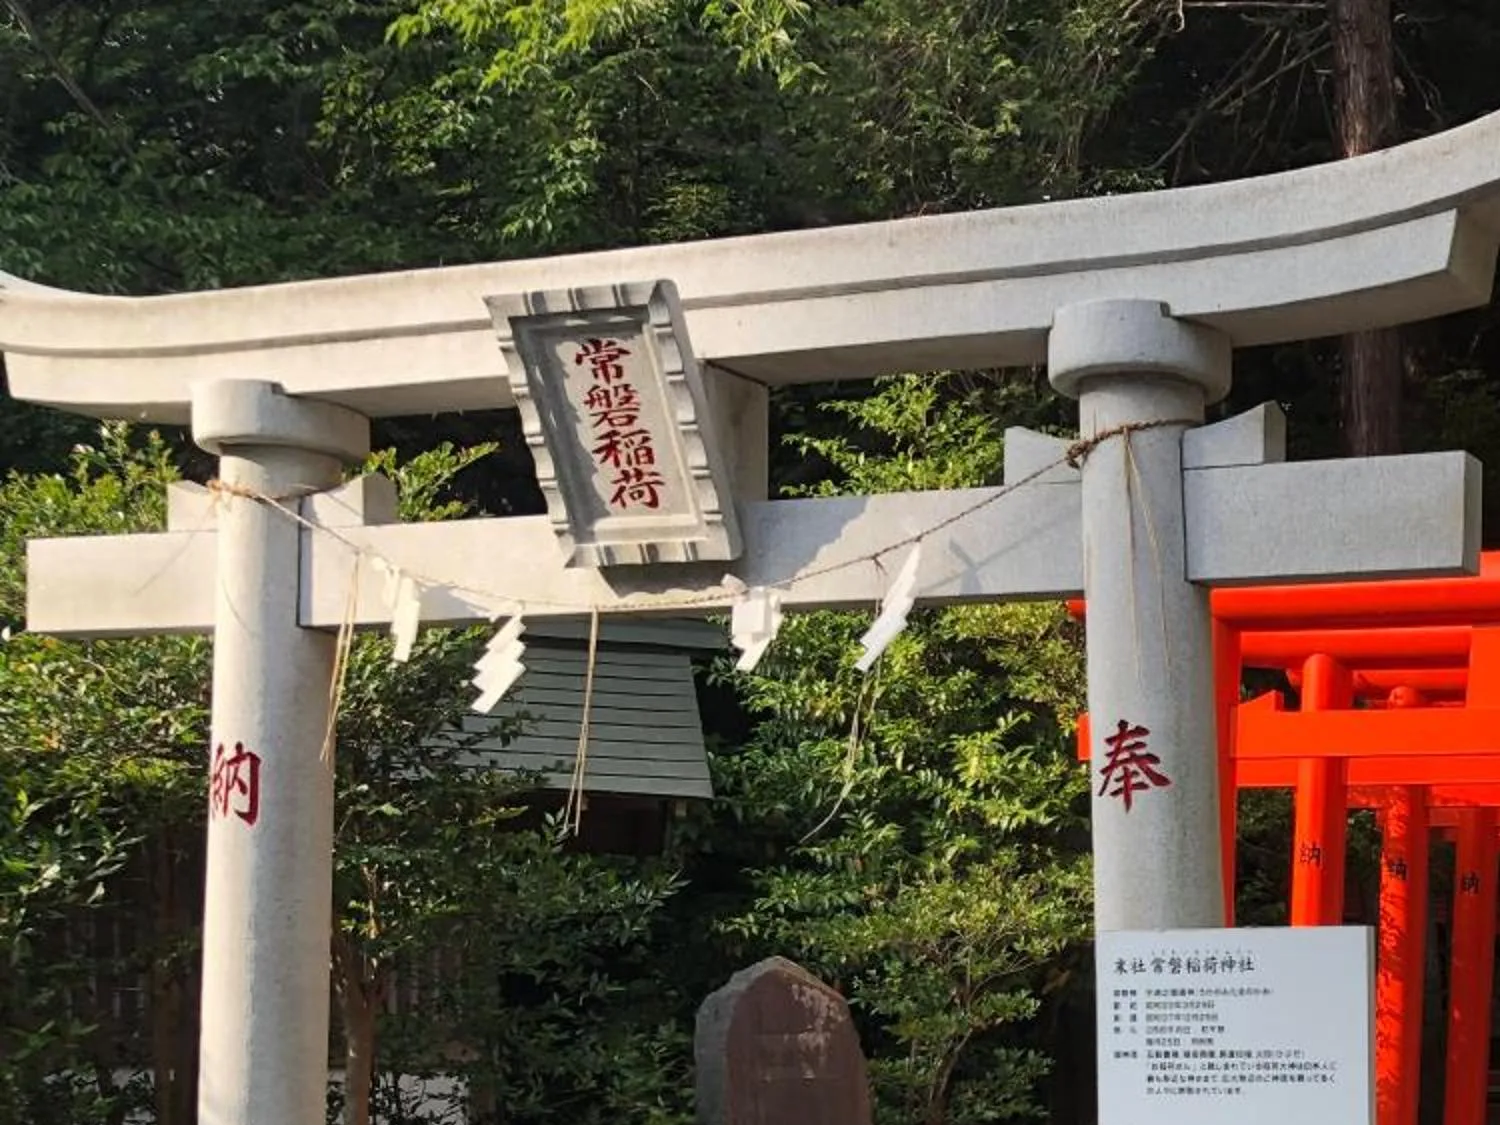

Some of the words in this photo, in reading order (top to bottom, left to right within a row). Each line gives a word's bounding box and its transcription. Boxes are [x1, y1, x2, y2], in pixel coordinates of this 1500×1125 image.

[575, 338, 666, 508] 常磐稲荷
[212, 741, 261, 826] 納
[1098, 719, 1172, 813] 奉
